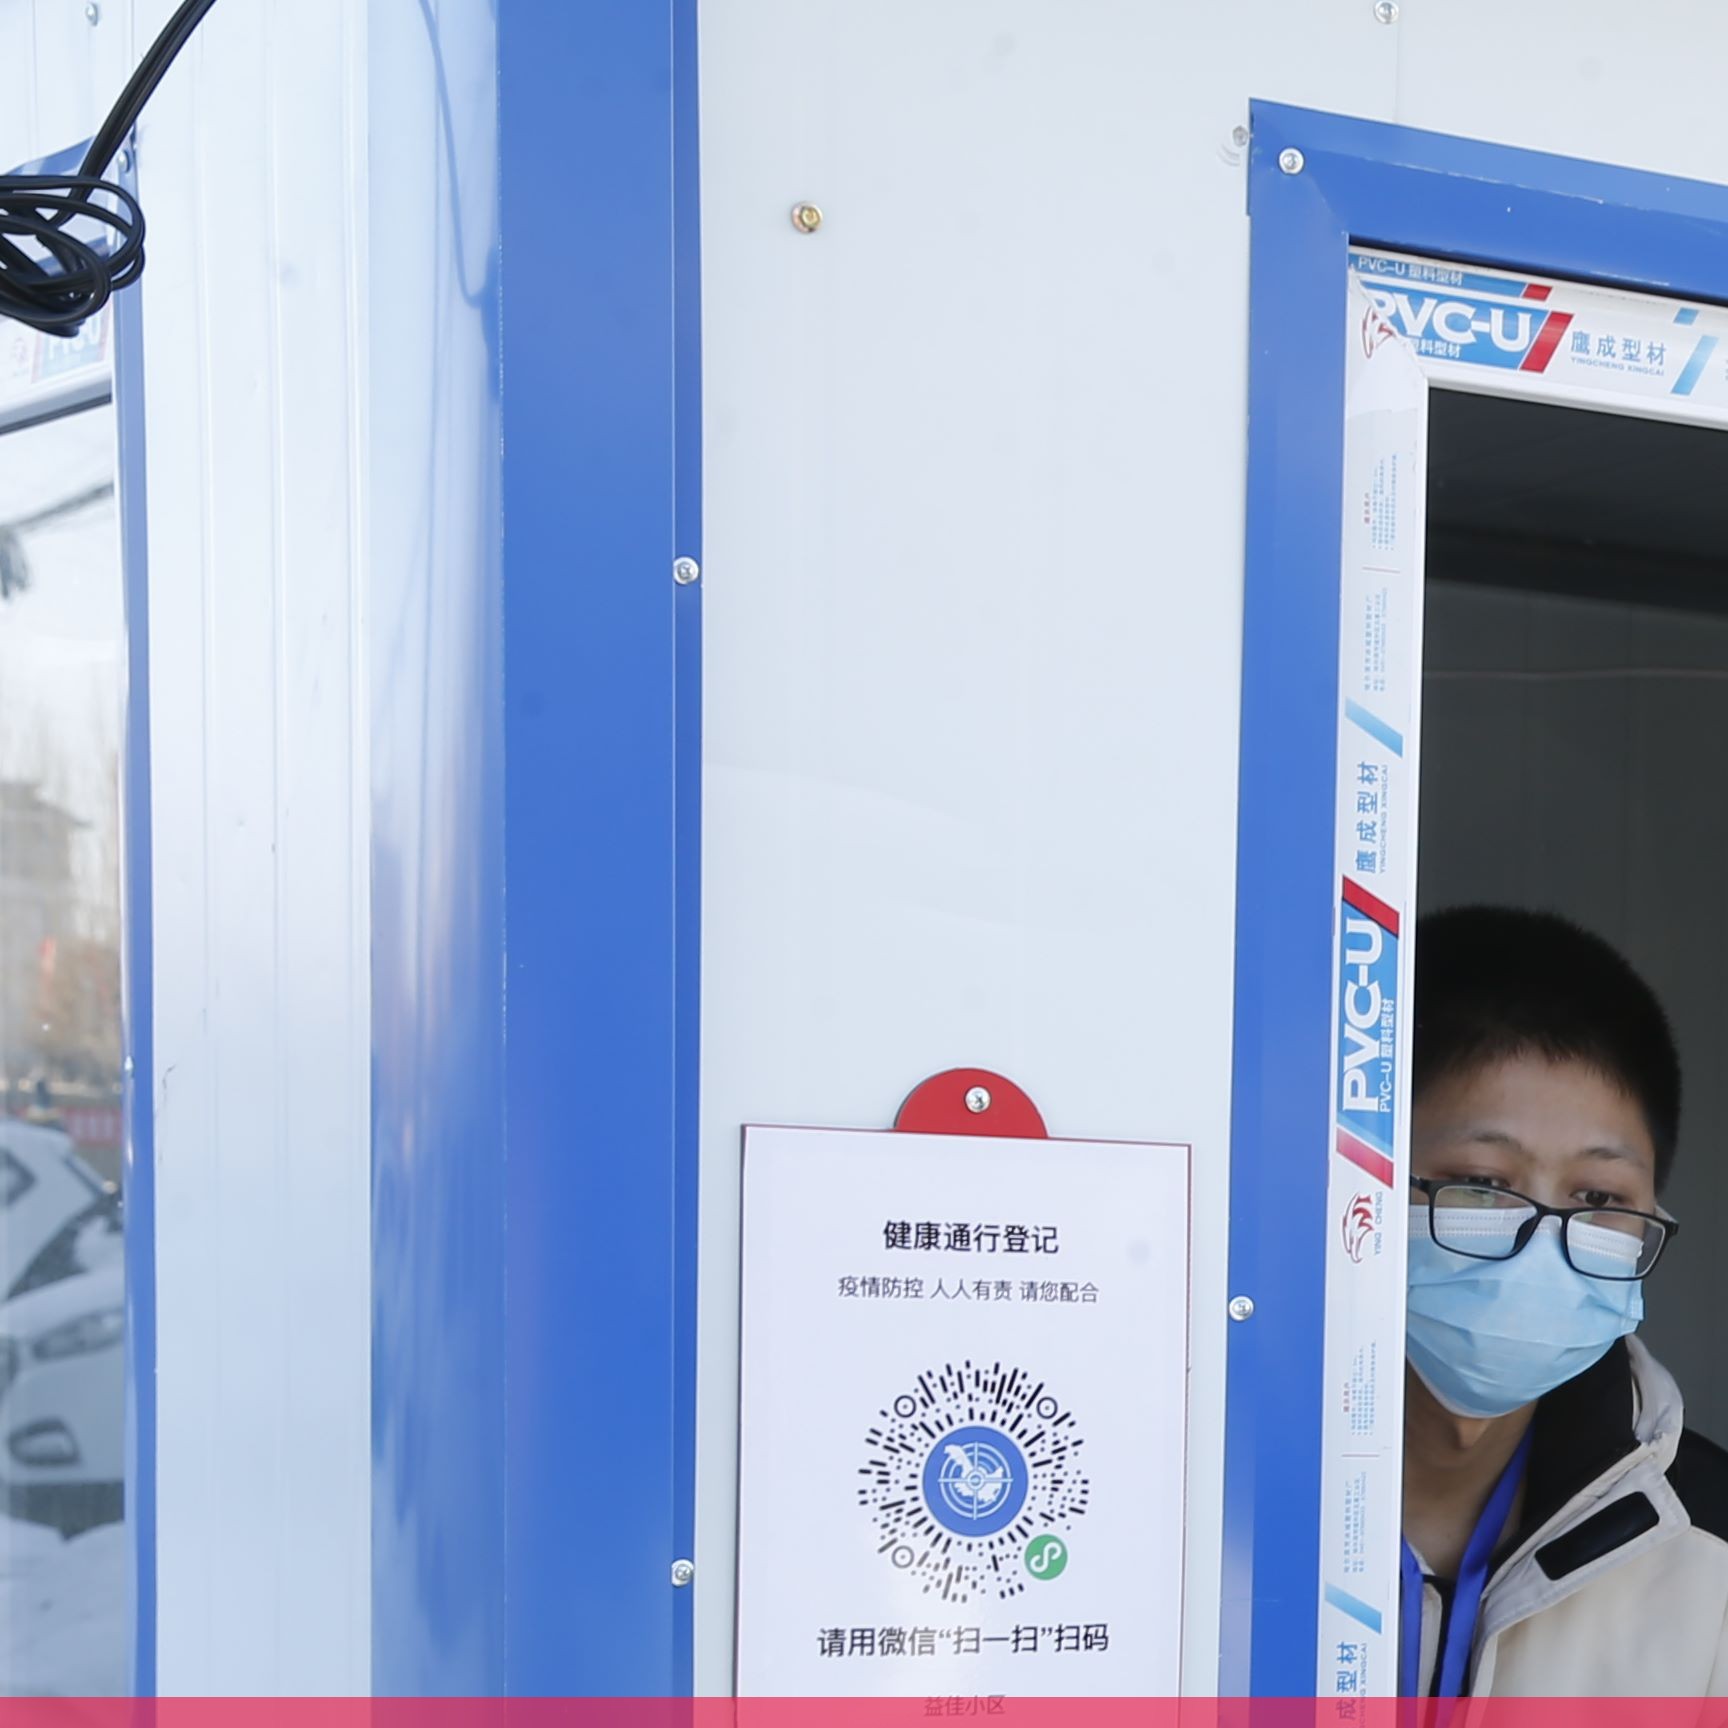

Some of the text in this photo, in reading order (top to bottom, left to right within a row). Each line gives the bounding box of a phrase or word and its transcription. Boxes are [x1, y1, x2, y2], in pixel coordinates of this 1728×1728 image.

[1358, 256, 1406, 276] PVC-U
[1570, 330, 1667, 366] 鹰成型材
[1354, 761, 1379, 874] 鹰成型材
[1342, 917, 1384, 1113] PVC-U
[1379, 1062, 1394, 1113] PVC-U
[883, 1220, 1059, 1256] 健康通行登记
[837, 1275, 1100, 1304] 疫情防控 人人有责 请您配合
[817, 1623, 1110, 1659] 请用微信“扫一扫”扫码
